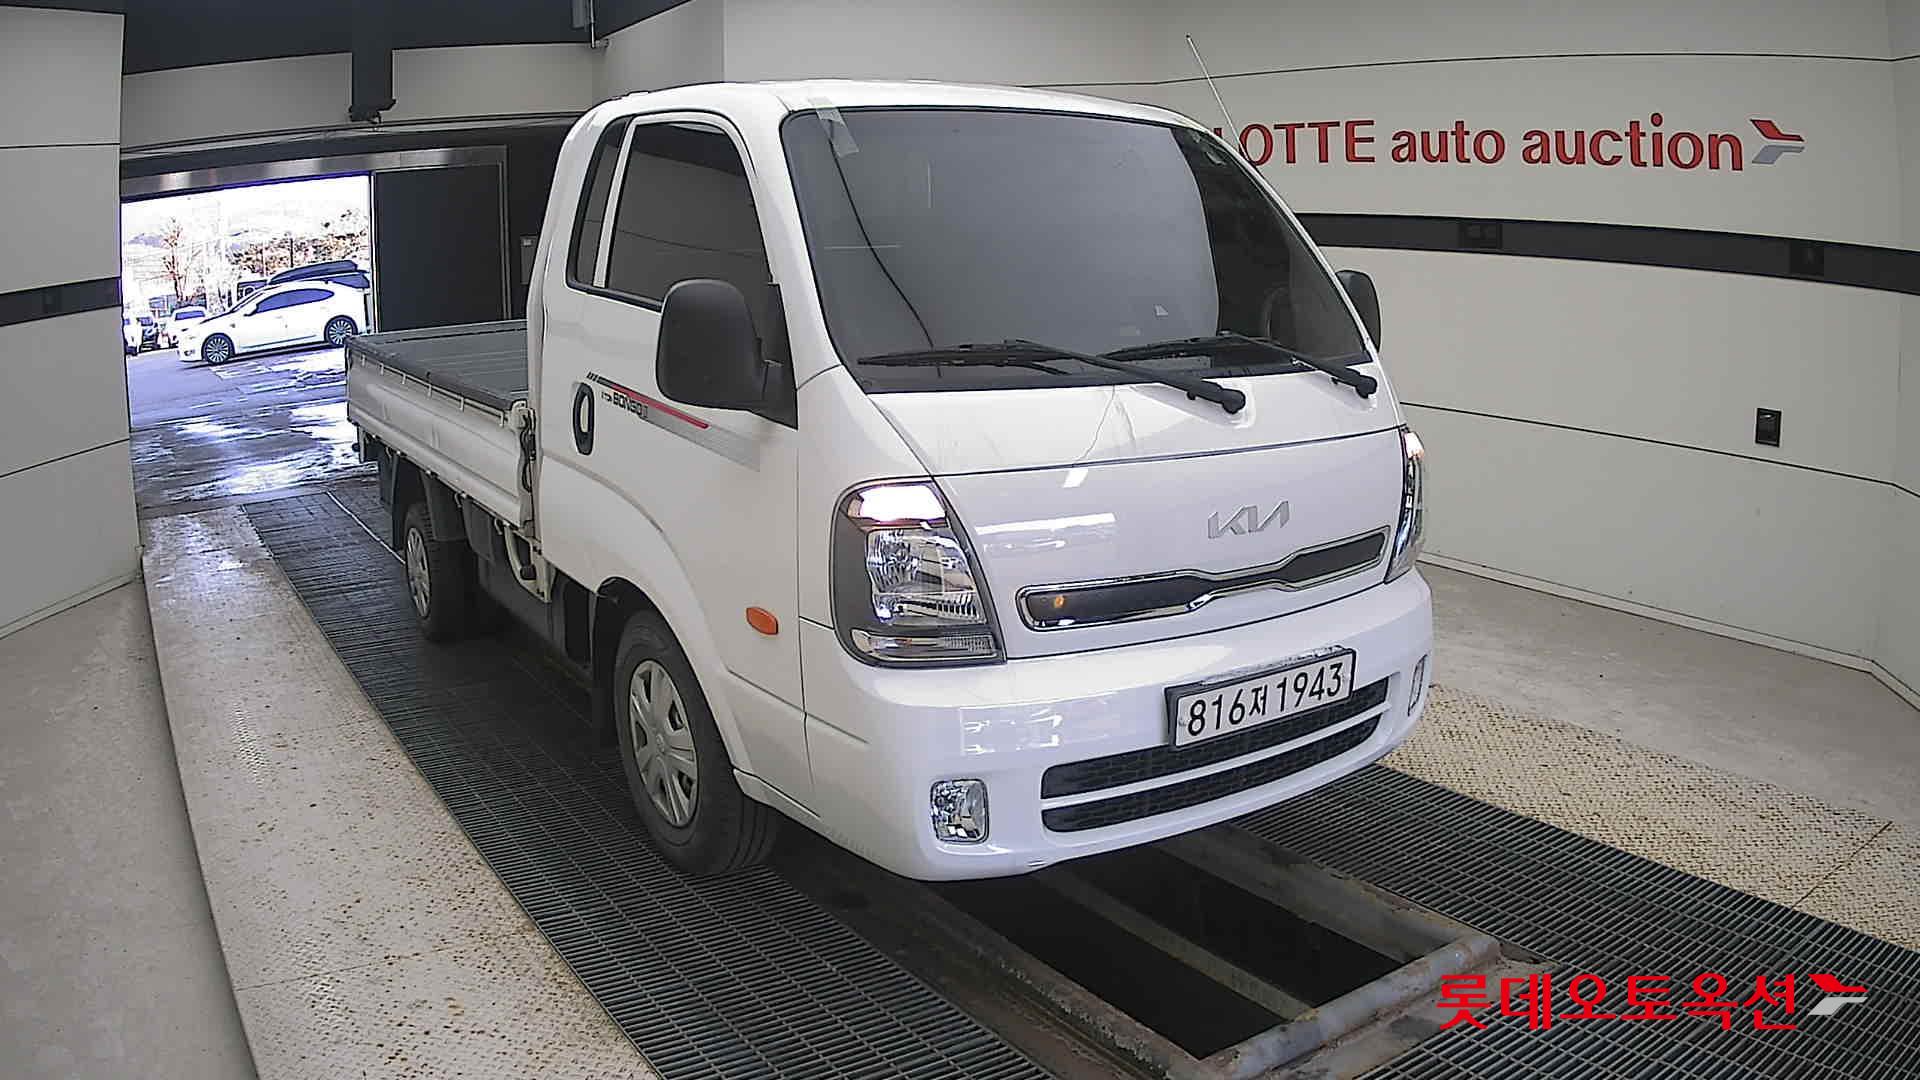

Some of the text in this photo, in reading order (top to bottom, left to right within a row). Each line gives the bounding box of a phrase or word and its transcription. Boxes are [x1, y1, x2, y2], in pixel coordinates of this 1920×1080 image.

[1213, 113, 1744, 171] OTTE auto auction
[1207, 499, 1290, 539] KIA
[1187, 662, 1344, 736] 816저 1943
